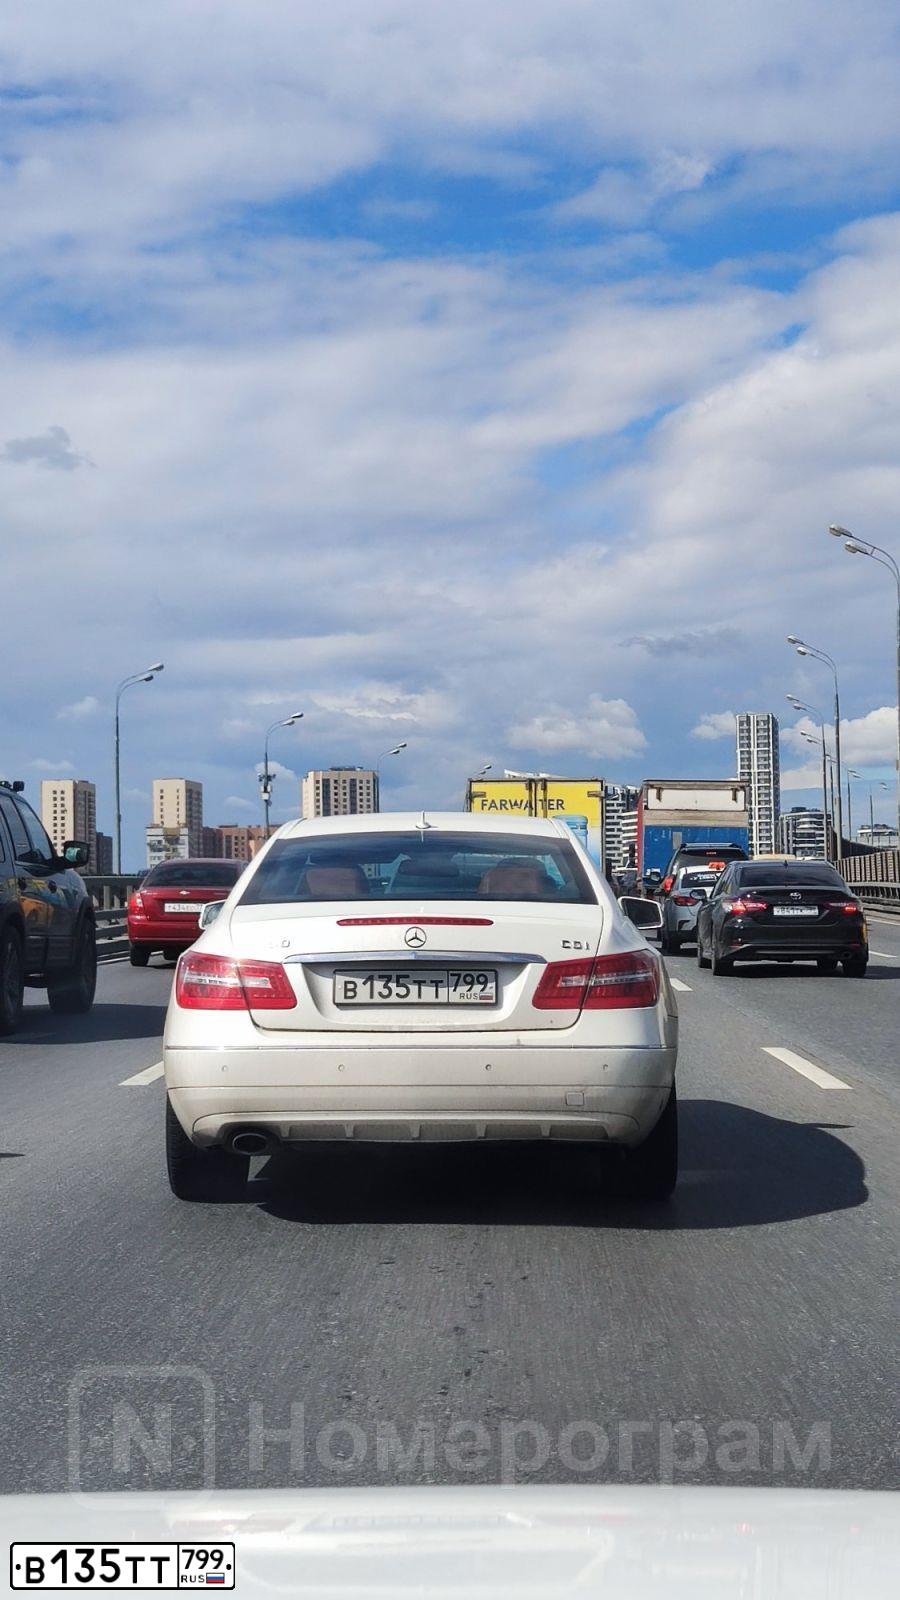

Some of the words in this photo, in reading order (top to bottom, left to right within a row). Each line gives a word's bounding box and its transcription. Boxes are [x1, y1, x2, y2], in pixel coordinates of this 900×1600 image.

[481, 799, 565, 811] FARWATER
[343, 974, 444, 1000] В135ТТ
[450, 973, 489, 993] 799
[459, 992, 478, 1000] RUS
